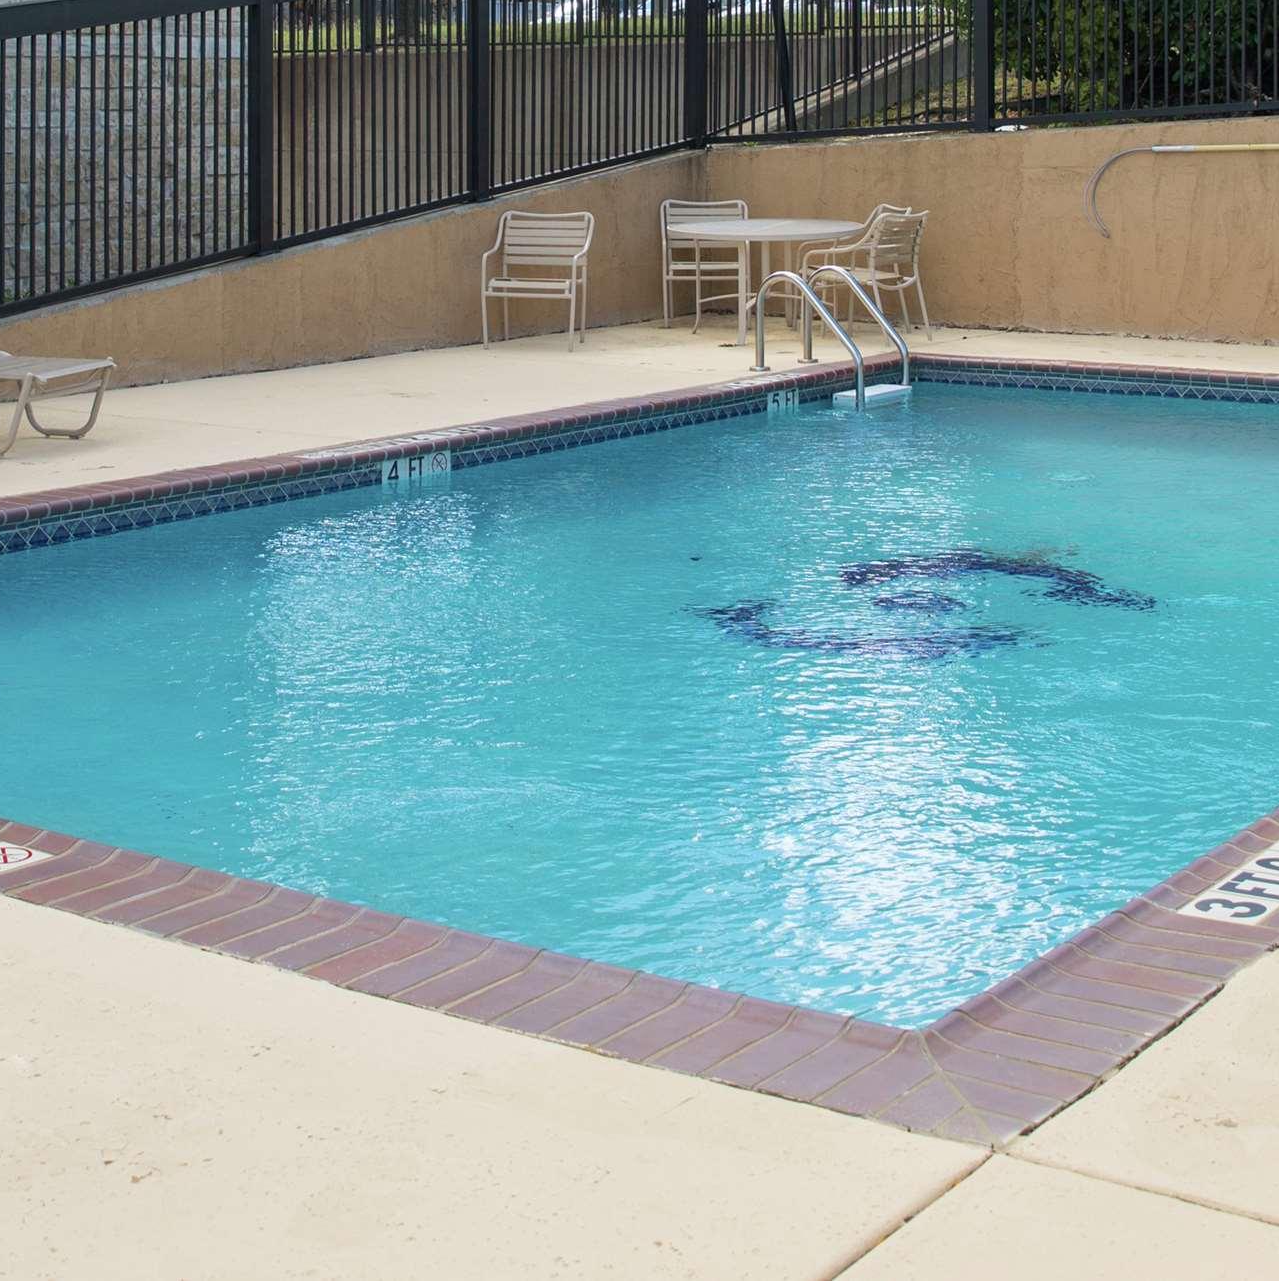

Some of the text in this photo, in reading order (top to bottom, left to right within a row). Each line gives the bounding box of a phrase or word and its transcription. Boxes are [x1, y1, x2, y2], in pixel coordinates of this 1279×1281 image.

[785, 389, 796, 411] FT
[387, 456, 425, 480] 4 FT
[1194, 897, 1268, 919] 3
